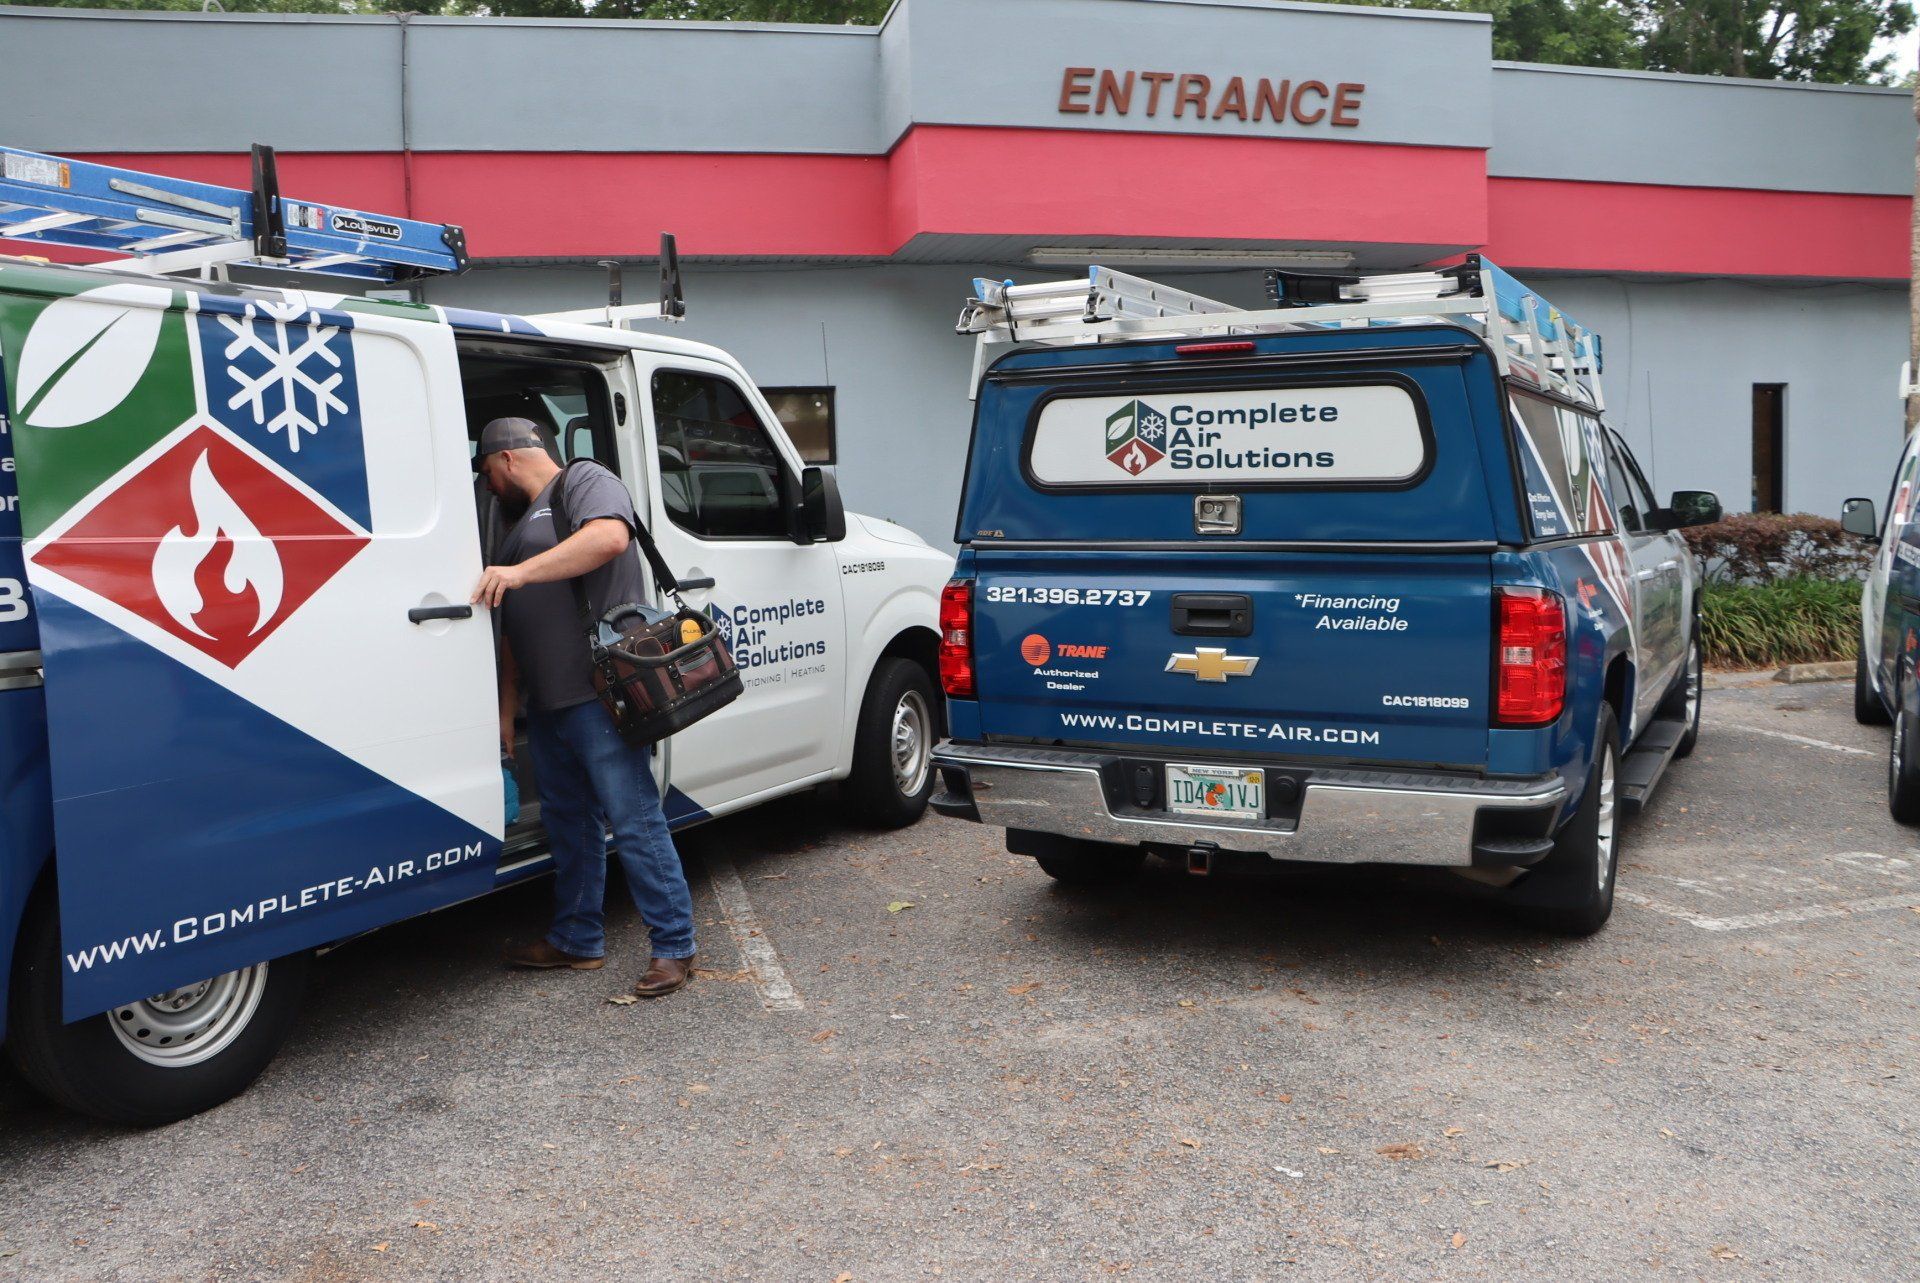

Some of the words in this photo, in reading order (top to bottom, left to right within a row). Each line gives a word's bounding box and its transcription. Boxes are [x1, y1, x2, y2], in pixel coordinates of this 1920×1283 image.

[1058, 67, 1365, 127] ENTRANCE
[344, 220, 400, 236] LOUISVILLE
[1170, 402, 1338, 430] Complete
[1169, 427, 1222, 448] Air
[1170, 447, 1335, 470] Solutions
[842, 561, 885, 575] CAC1818099
[986, 586, 1151, 607] 321.396.2737
[733, 598, 825, 626] Complete
[1315, 615, 1409, 631] Available
[735, 626, 766, 648] Air
[735, 640, 826, 670] Solutions
[1057, 644, 1107, 659] TRANE
[743, 674, 781, 688] ITIONING
[791, 664, 826, 678] HEATING
[1033, 667, 1099, 679] Authorized
[1046, 681, 1086, 691] Dealer
[1382, 695, 1470, 709] CAC1818099
